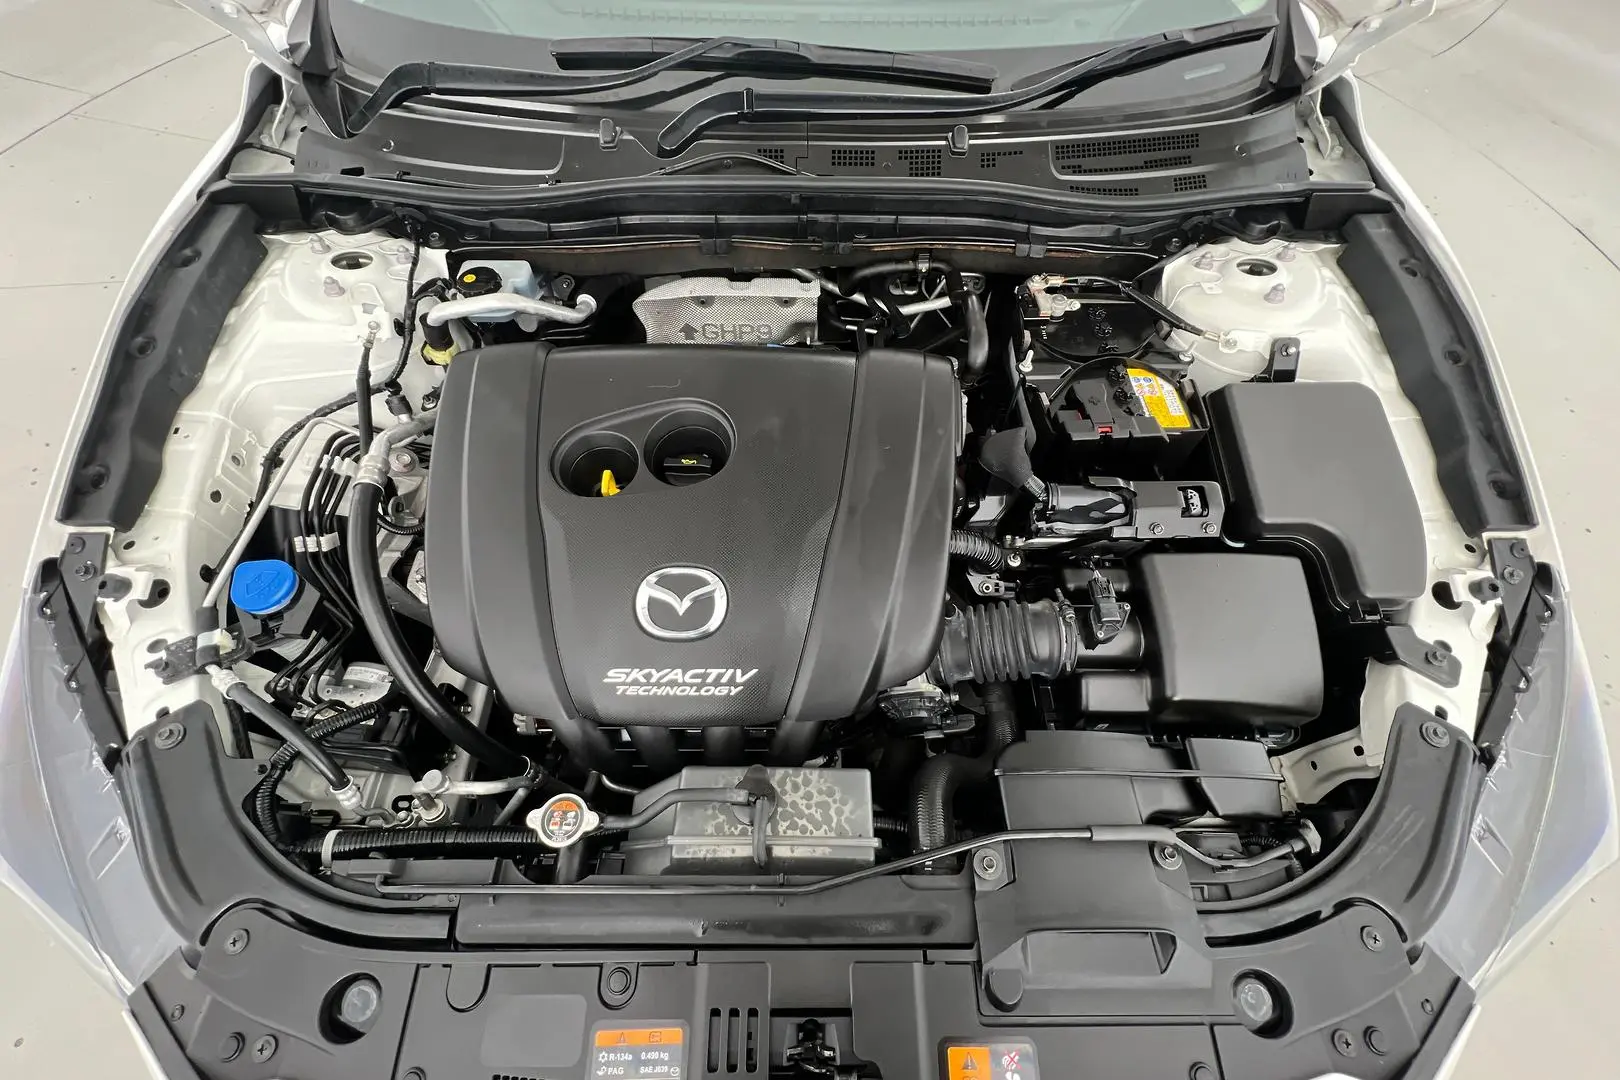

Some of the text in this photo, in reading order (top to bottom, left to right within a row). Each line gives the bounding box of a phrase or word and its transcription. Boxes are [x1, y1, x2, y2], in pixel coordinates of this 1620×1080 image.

[602, 668, 759, 683] SKYACTIV
[615, 685, 744, 696] TECHNOLOGY
[609, 1053, 633, 1061] R-134a
[660, 1051, 669, 1061] kg
[607, 1067, 624, 1075] PAG
[640, 1066, 653, 1074] SAE
